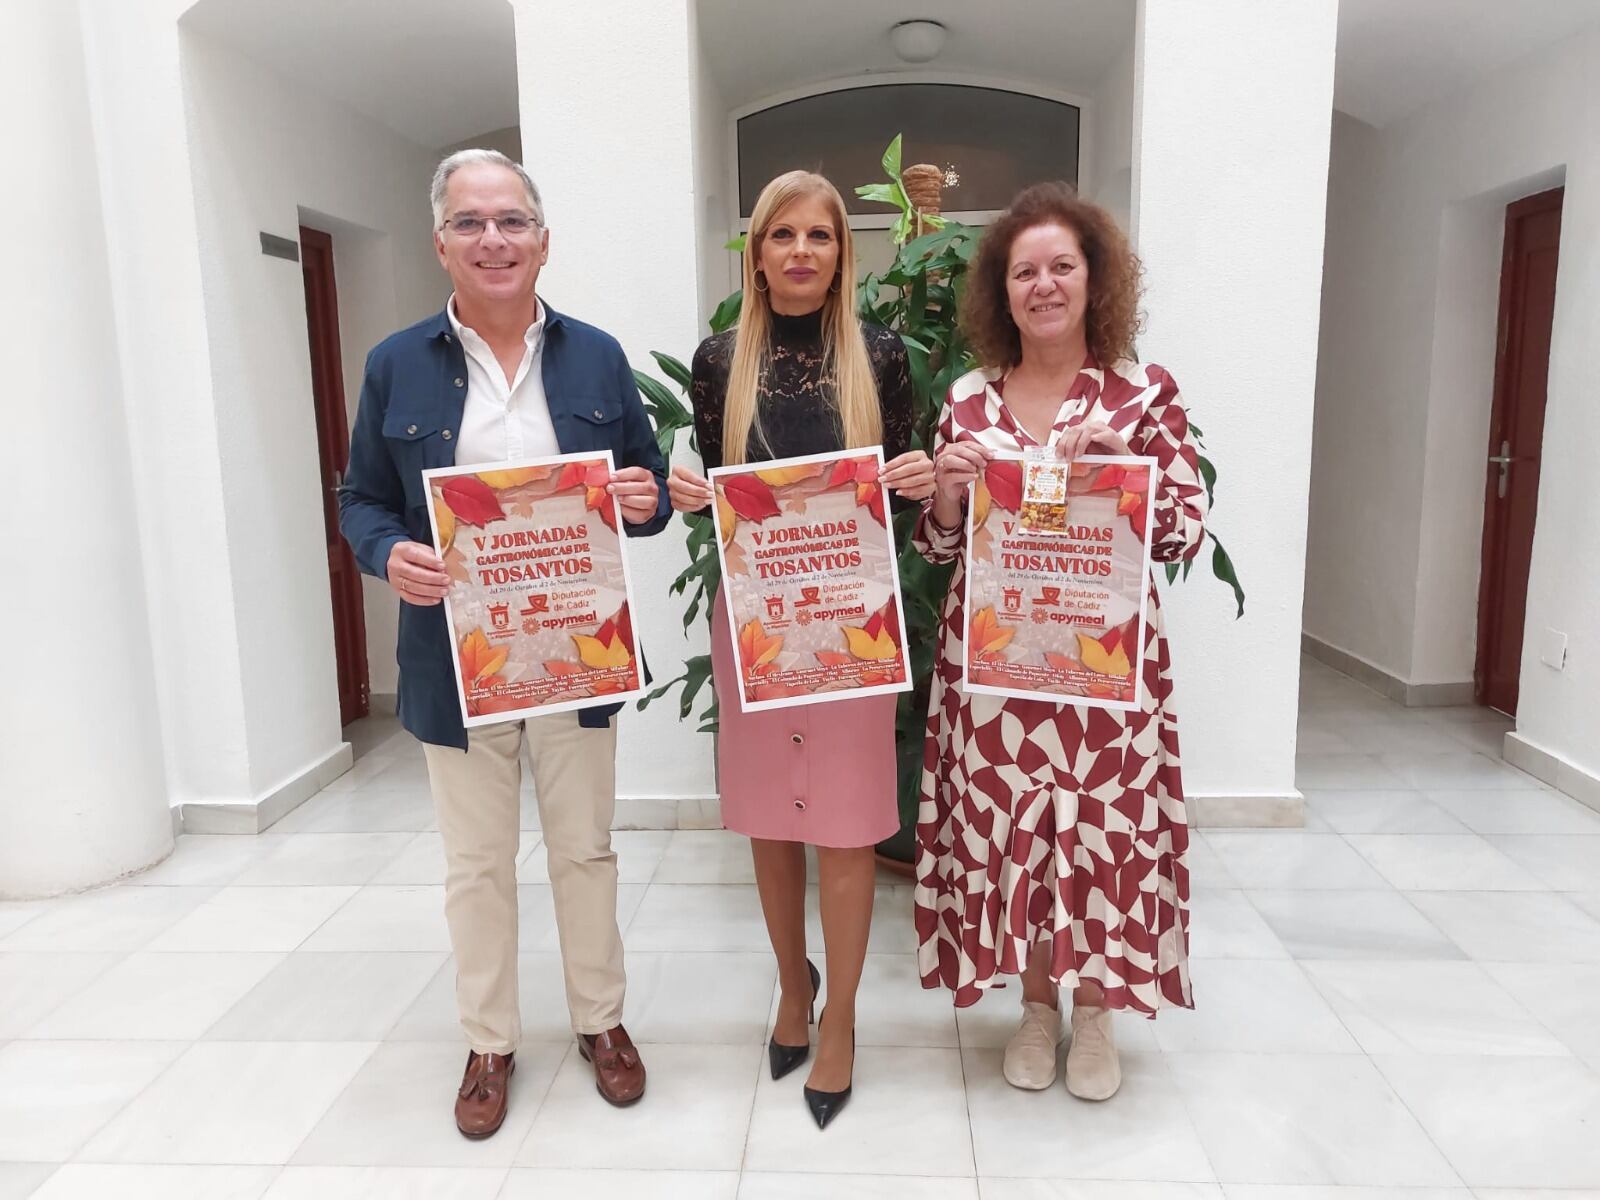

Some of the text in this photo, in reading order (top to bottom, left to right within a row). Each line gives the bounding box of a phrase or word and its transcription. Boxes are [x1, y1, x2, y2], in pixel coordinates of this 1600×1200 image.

[752, 520, 857, 546] V JORNADAS
[1003, 521, 1015, 536] V
[474, 524, 588, 551] V JORNADAS
[476, 543, 590, 566] GASTRONÓMICAS DE
[754, 537, 859, 559] GASTRONÓMICAS DE
[1001, 540, 1112, 556] GASTRONÓMICAS DE
[478, 556, 593, 586] TOSANTOS
[756, 551, 861, 578] TOSANTOS
[1001, 553, 1112, 577] TOSANTOS
[551, 588, 596, 601] Diputación
[823, 582, 864, 593] Diputación
[1064, 588, 1110, 600] Diputación
[553, 599, 589, 611] de Cádiz
[824, 593, 858, 603] de Cádiz
[1064, 599, 1101, 611] de Cádiz
[541, 610, 597, 630] apymeal
[813, 603, 865, 621] apymeal
[1050, 612, 1105, 625] apymeal
